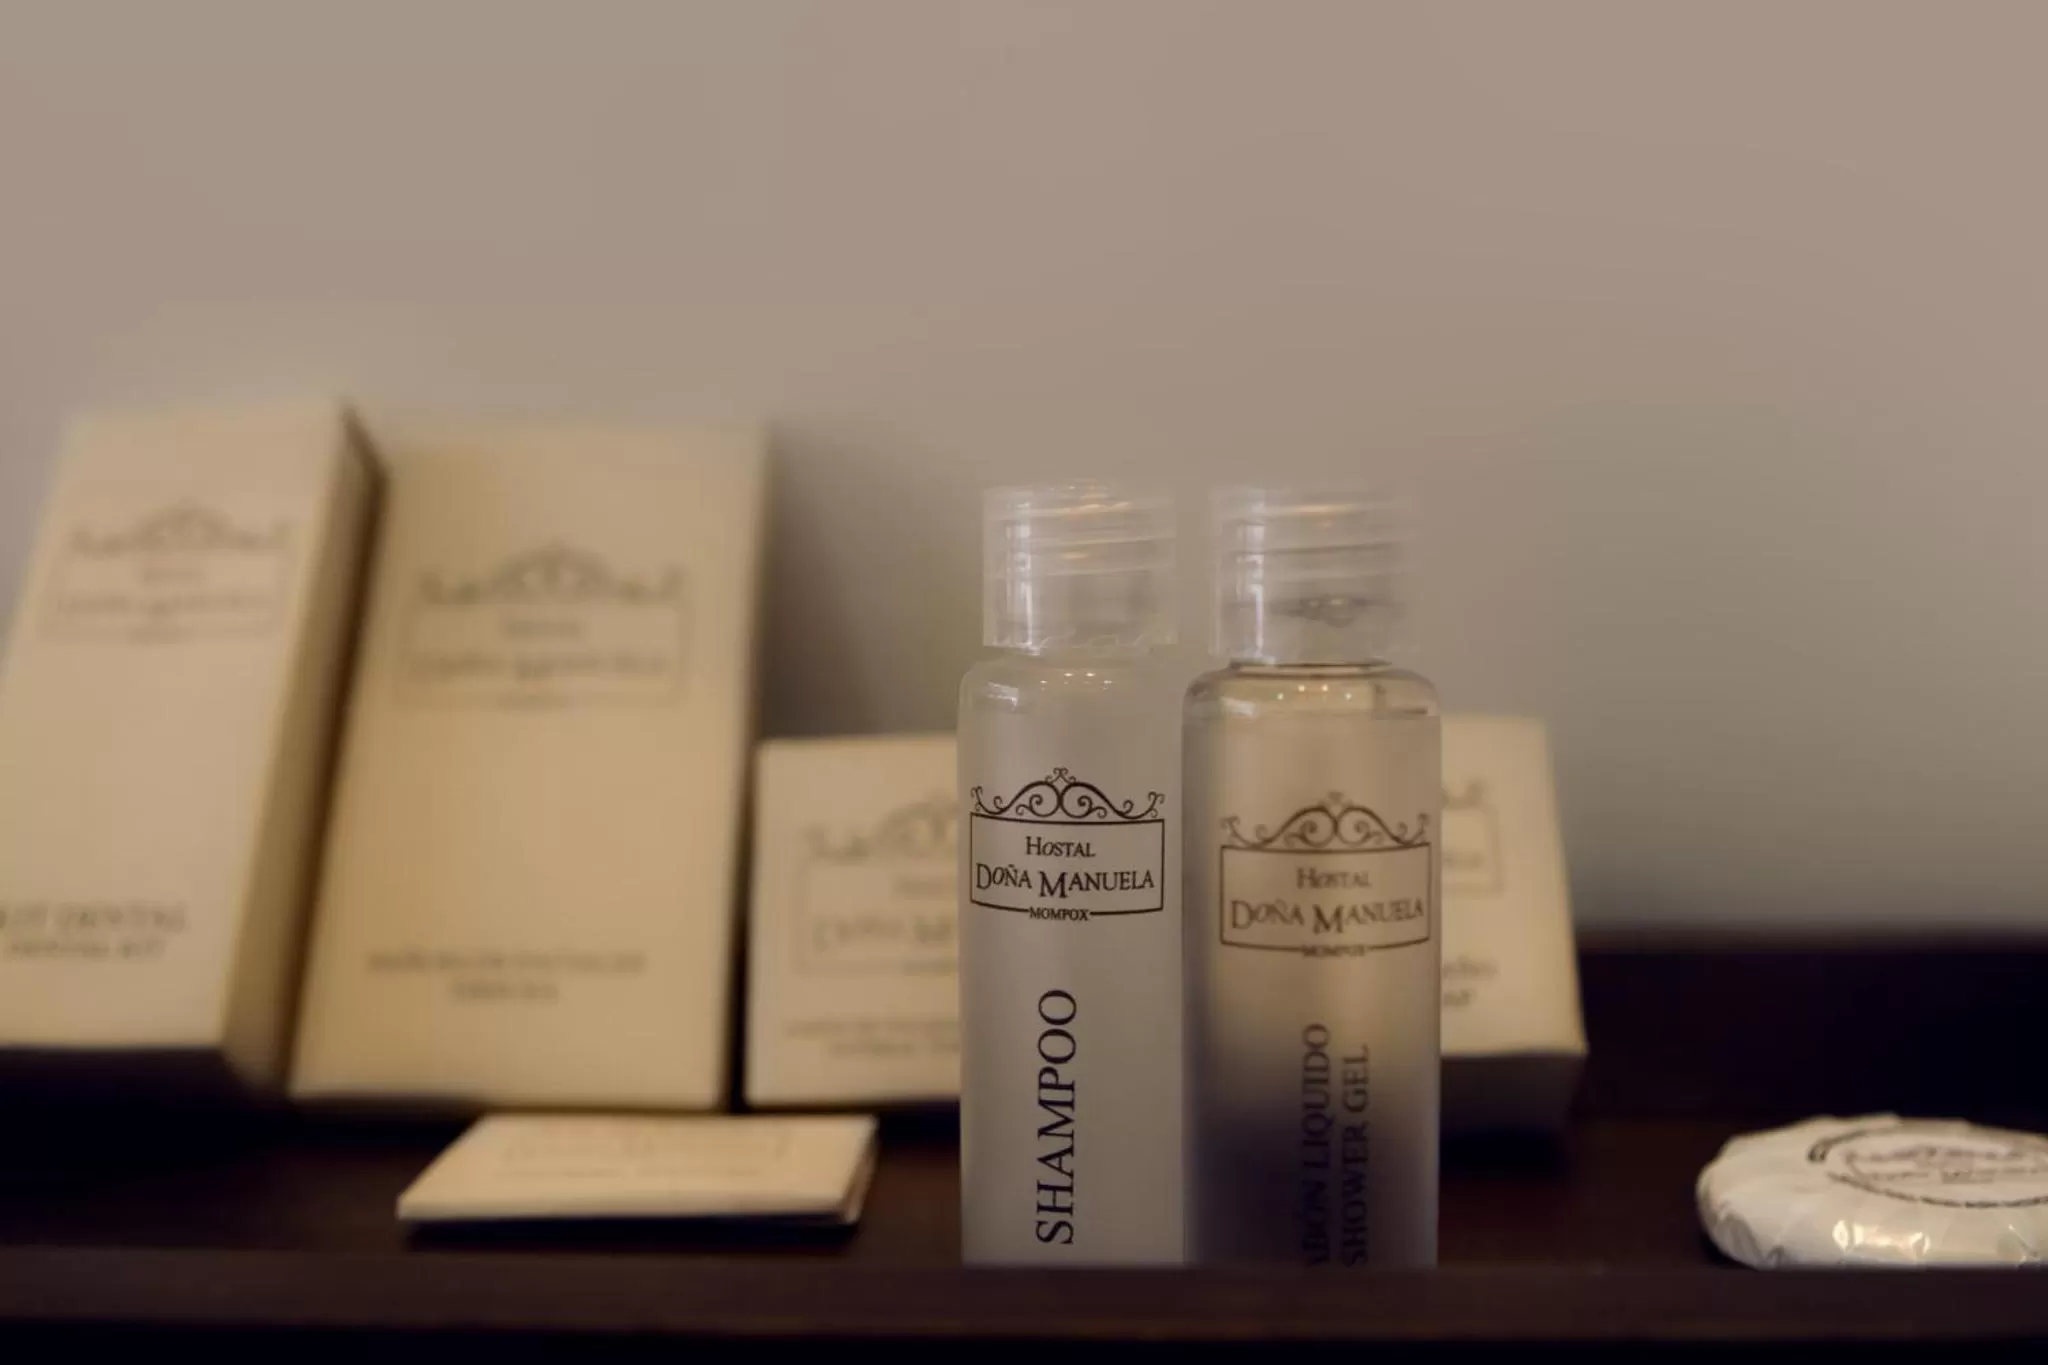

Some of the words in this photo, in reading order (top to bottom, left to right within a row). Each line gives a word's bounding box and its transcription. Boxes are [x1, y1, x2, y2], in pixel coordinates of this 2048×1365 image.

[1026, 836, 1096, 858] HOSTAL
[976, 863, 1032, 890] DOÑA
[1038, 870, 1155, 898] MANUELA
[1028, 906, 1091, 922] MOMPOX
[1341, 1043, 1370, 1114] GEL
[1036, 989, 1077, 1245] SHAMPOO
[1341, 1121, 1370, 1267] SHOWER
